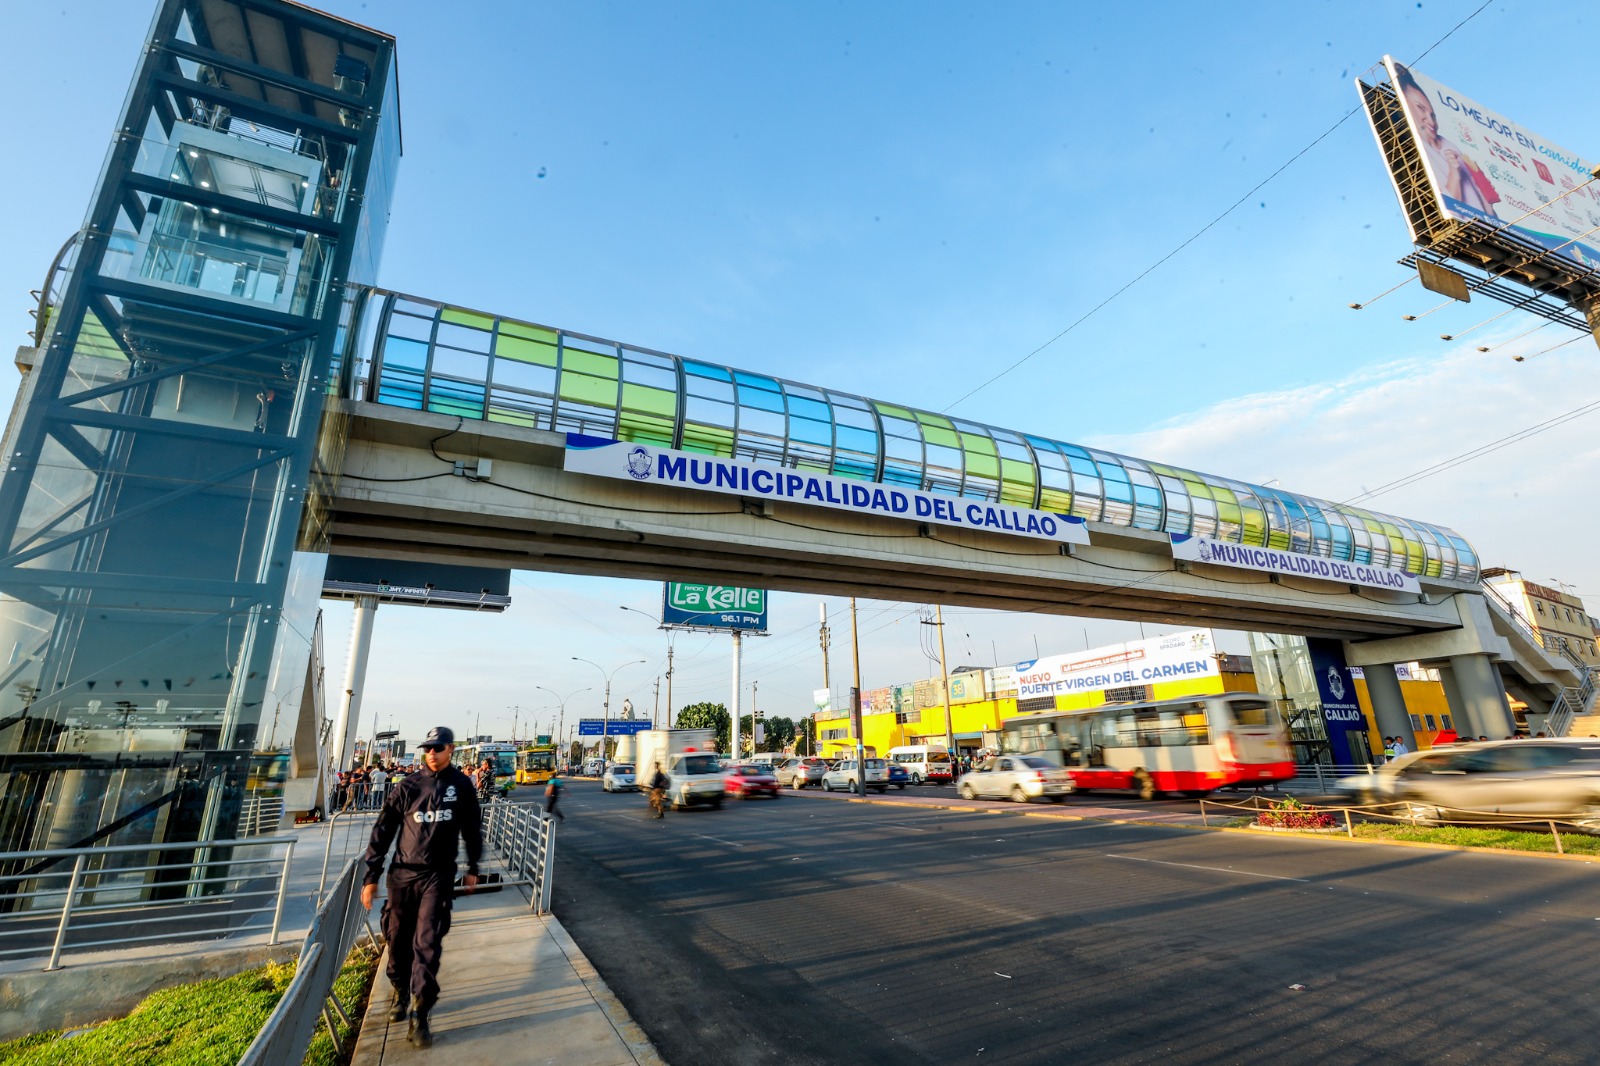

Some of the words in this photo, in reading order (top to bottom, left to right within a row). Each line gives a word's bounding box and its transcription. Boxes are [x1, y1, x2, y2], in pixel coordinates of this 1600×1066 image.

[1437, 90, 1460, 112] LO
[1461, 103, 1514, 141] MEJOR
[1515, 131, 1537, 152] EN
[1538, 145, 1593, 181] comidas
[657, 454, 909, 514] MUNICIPALIDAD
[915, 495, 962, 523] DEL
[966, 504, 1057, 536] CALLAO
[1210, 543, 1330, 577] MUNICIPALIDAD
[1331, 562, 1356, 581] DEL
[1356, 567, 1404, 588] CALLAO
[673, 583, 700, 605] La
[705, 585, 760, 610] Kalle
[721, 614, 740, 623] 96.1
[743, 616, 759, 624] FM
[1019, 672, 1051, 685] NUEVO
[1021, 682, 1063, 695] PUENTE
[1065, 674, 1111, 689] VIRGEN
[1113, 670, 1139, 684] DEL
[1141, 659, 1209, 679] CARMEN
[1324, 709, 1360, 721] CALLAO
[413, 808, 453, 823] GOES
